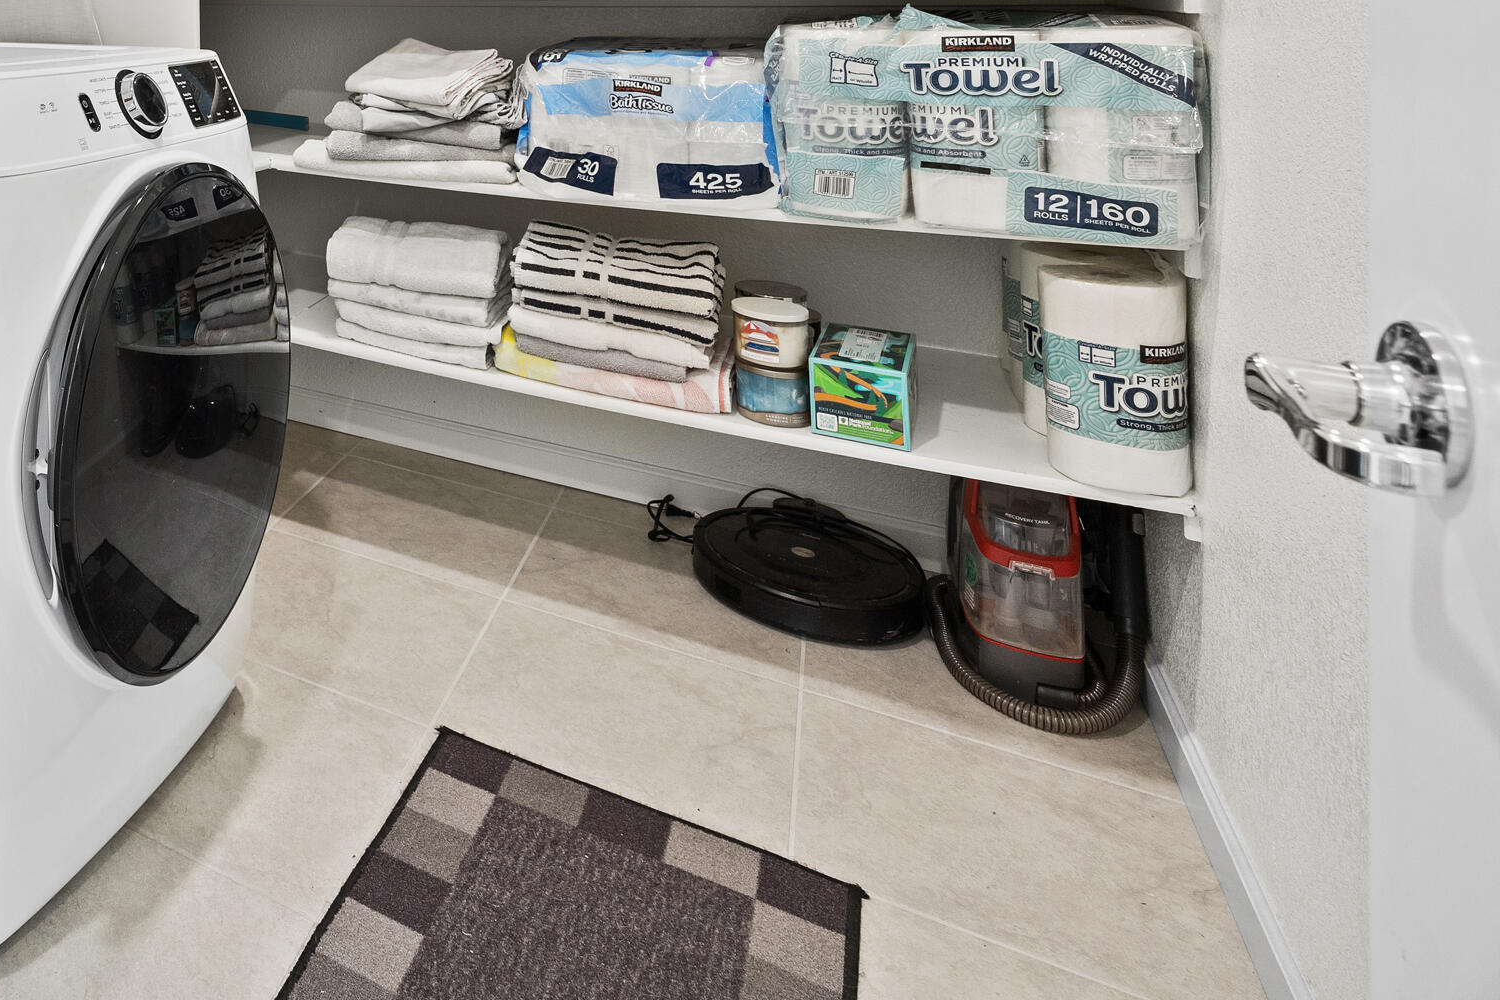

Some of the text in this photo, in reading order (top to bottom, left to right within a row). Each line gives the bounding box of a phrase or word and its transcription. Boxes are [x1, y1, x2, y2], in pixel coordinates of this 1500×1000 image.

[945, 37, 1012, 46] KIRKLAND
[938, 57, 1020, 68] PREMIUM
[1101, 44, 1174, 82] INDIVIDUALLY
[1089, 48, 1176, 93] WRAPPED ROLLS
[902, 60, 1060, 94] Towel
[614, 80, 661, 92] KIRKLAND
[610, 94, 636, 110] Bath
[634, 96, 674, 114] Tissue
[827, 106, 899, 116] PREMIUM
[938, 150, 983, 158] Absorbent
[577, 158, 600, 176] 30
[577, 174, 594, 183] ROLLS
[689, 172, 744, 190] 425
[1034, 192, 1150, 227] 12 160
[1033, 210, 1152, 234] ROLLS SHEETS PER ROLL
[850, 418, 872, 426] National
[1120, 419, 1156, 431] Strong,
[1004, 512, 1034, 524] RECOVERY
